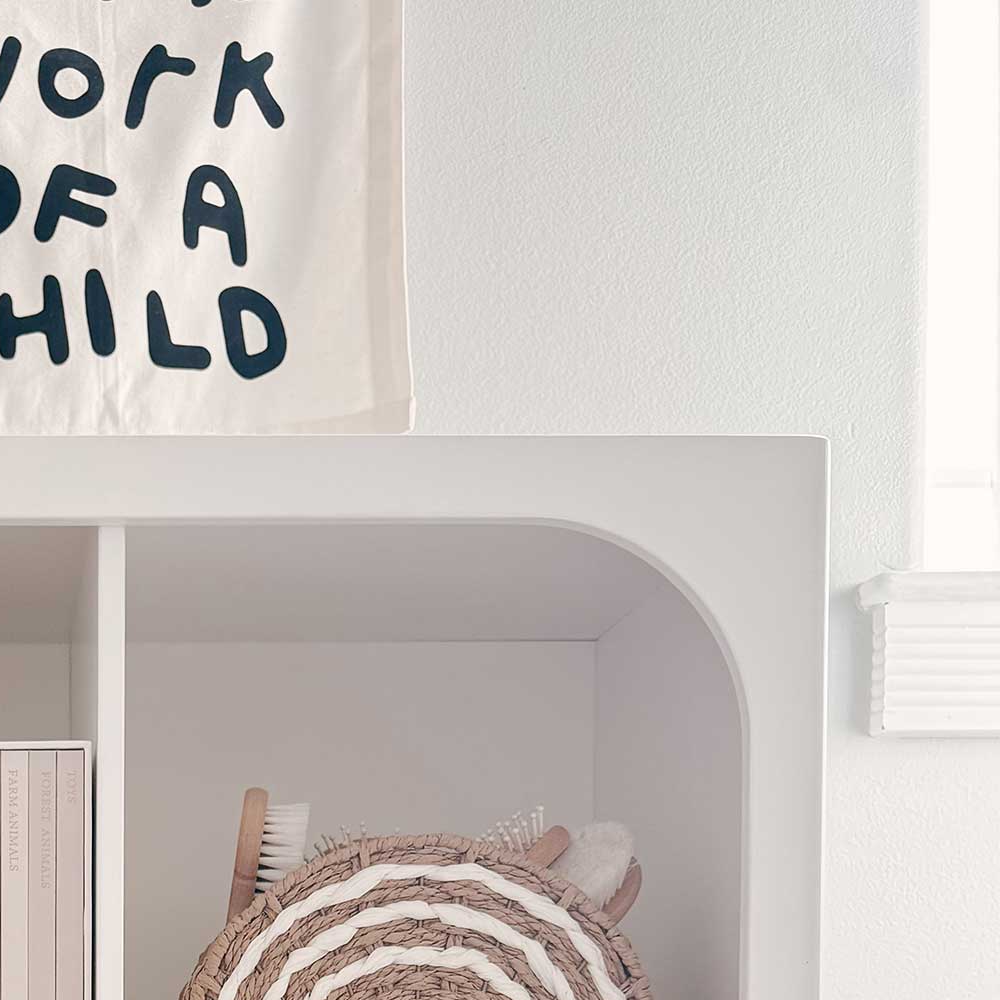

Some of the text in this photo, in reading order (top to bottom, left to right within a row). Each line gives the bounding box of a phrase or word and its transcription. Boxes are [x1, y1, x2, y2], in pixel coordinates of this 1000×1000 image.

[183, 164, 247, 267] A
[8, 769, 19, 872] FARM ANIMALS
[41, 771, 51, 889] FOREST ANIMALS
[66, 769, 77, 805] TOYS
